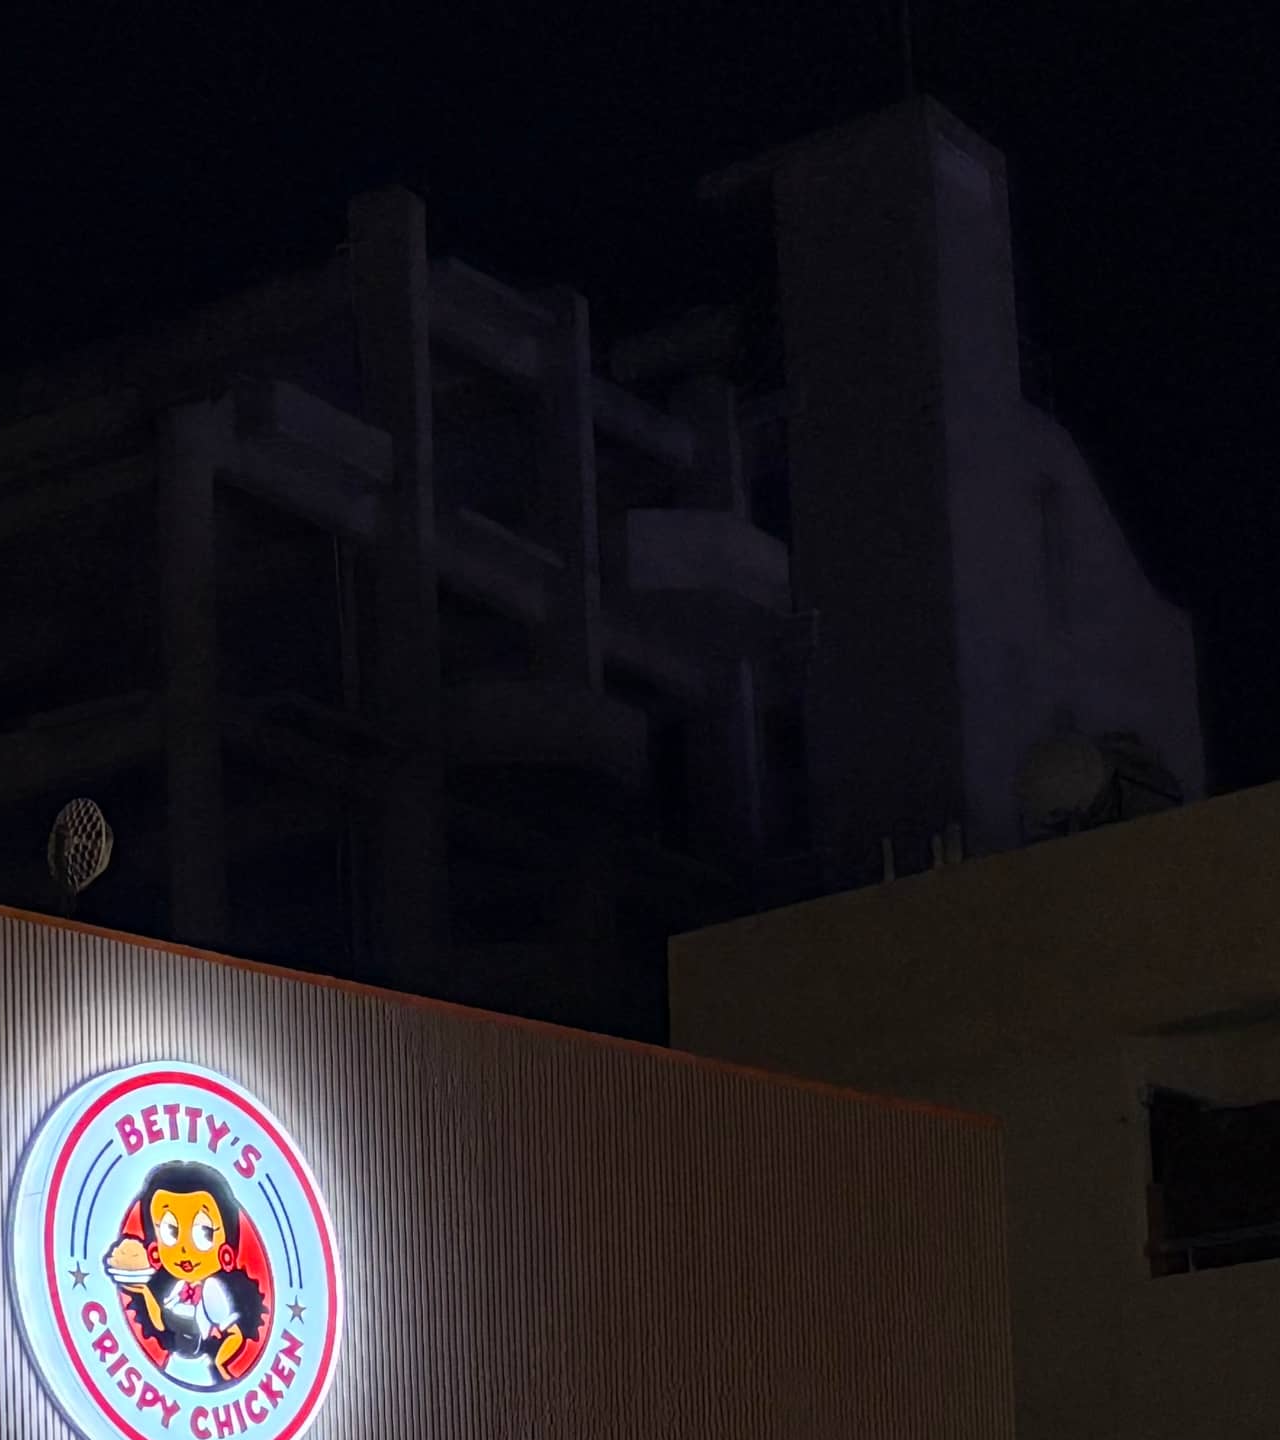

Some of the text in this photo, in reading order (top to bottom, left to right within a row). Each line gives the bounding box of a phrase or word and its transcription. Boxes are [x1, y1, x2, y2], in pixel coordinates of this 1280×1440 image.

[115, 1103, 262, 1180] BETTY'S
[81, 1301, 305, 1440] CRISPY CHICKEN
